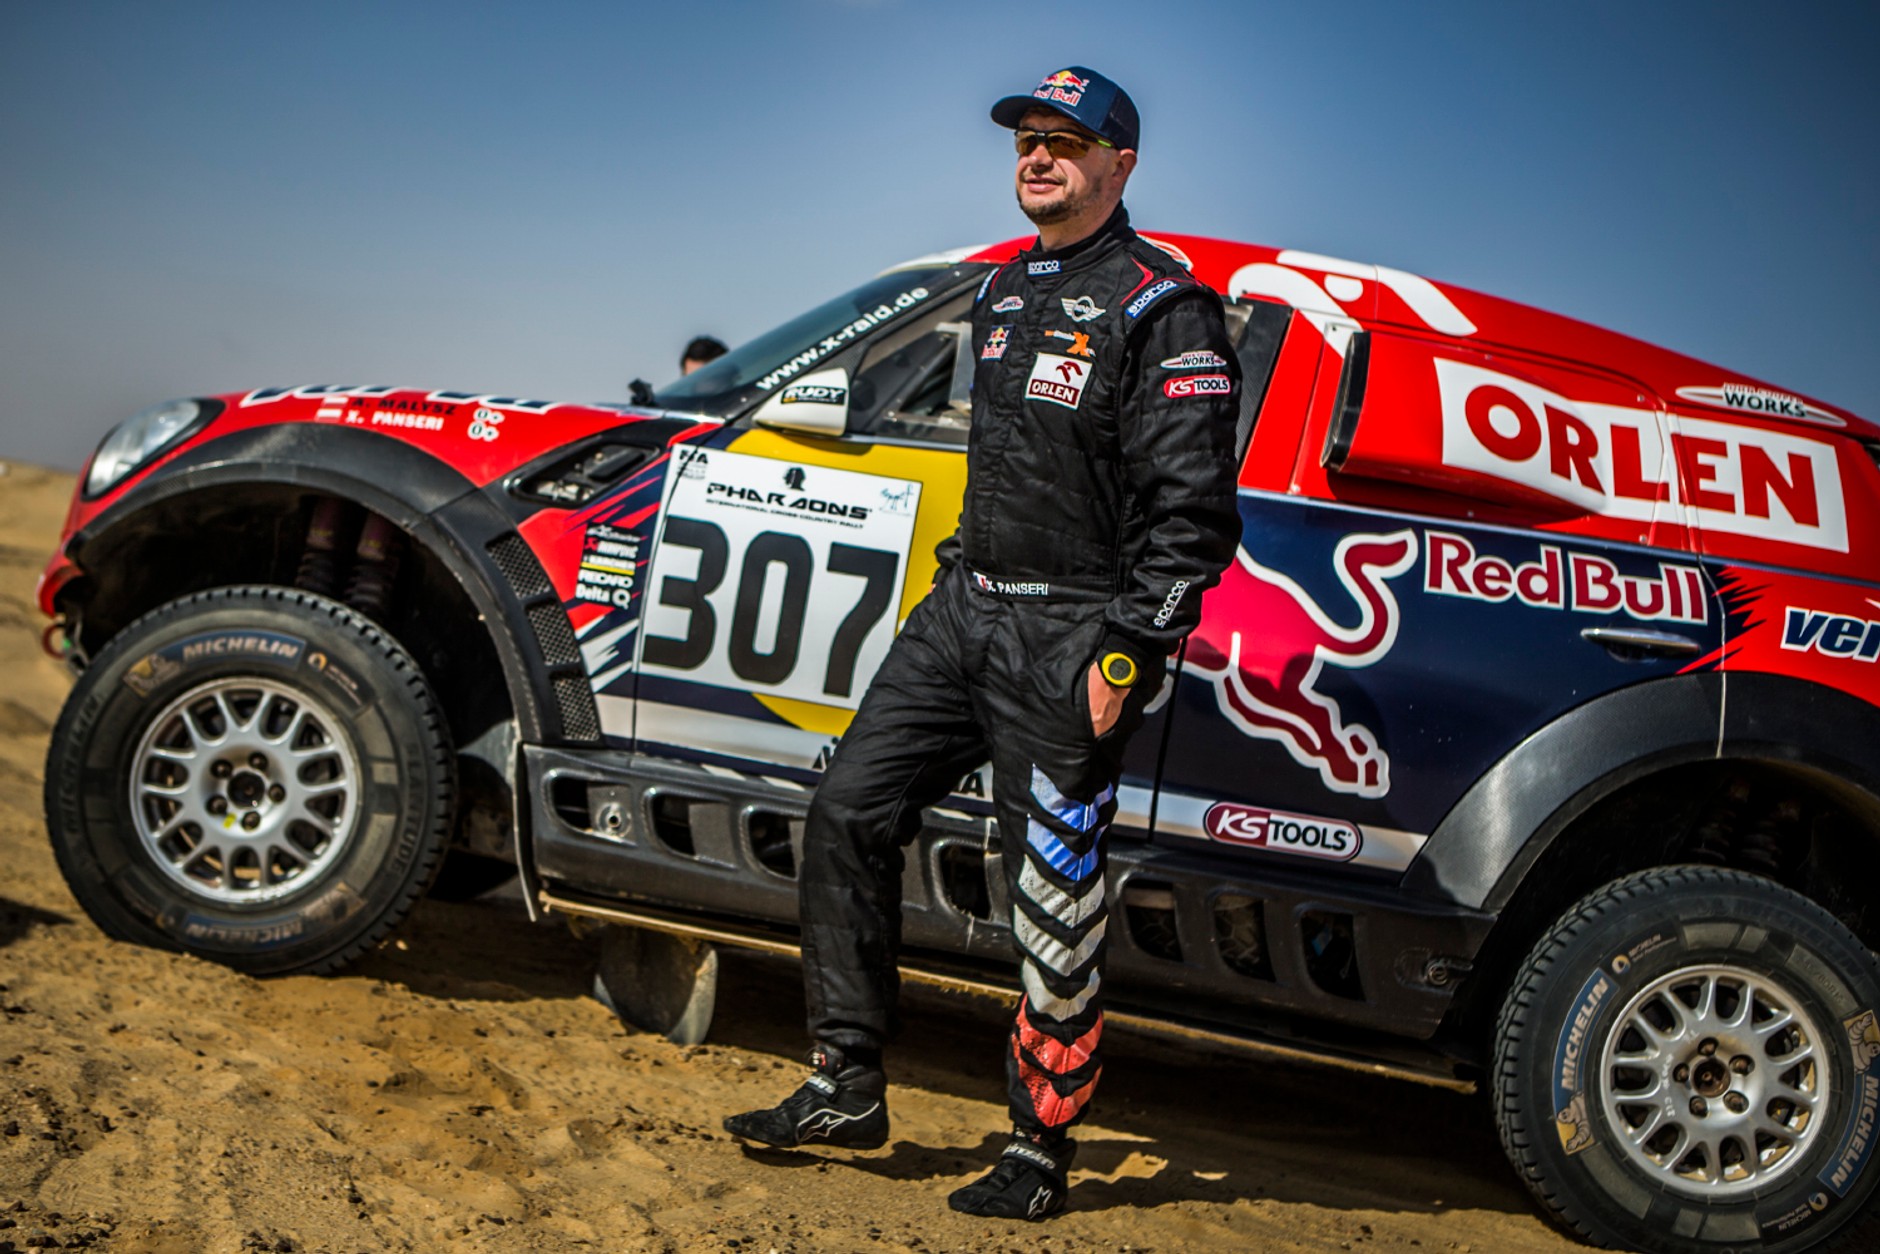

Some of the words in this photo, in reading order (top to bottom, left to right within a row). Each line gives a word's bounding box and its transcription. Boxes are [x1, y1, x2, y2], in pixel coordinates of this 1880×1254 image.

[1051, 88, 1081, 107] Bull
[1028, 260, 1060, 274] sparco
[1126, 280, 1178, 317] sparco
[755, 286, 930, 391] www.x-raid.de
[1181, 357, 1215, 367] WORKS
[784, 387, 845, 399] RUDY
[1032, 381, 1075, 402] ORLEN
[1168, 379, 1195, 397] KS
[1194, 380, 1229, 392] TOOLS
[1724, 391, 1807, 418] WORKS
[371, 411, 445, 431] PANSERI
[1465, 383, 1820, 529] ORLEN
[706, 482, 869, 521] PHARAONS
[996, 582, 1049, 596] PANSERI
[1425, 530, 1565, 610] Red
[1568, 551, 1709, 626] Bull
[576, 583, 611, 603] Delta
[641, 515, 899, 698] 307
[1153, 580, 1190, 628] sparco
[183, 637, 299, 661] MICHELIN
[1216, 809, 1269, 840] KS
[1267, 819, 1348, 851] TOOLS
[1561, 976, 1609, 1091] MICHELIN
[1831, 1075, 1880, 1189] MICHELIN
